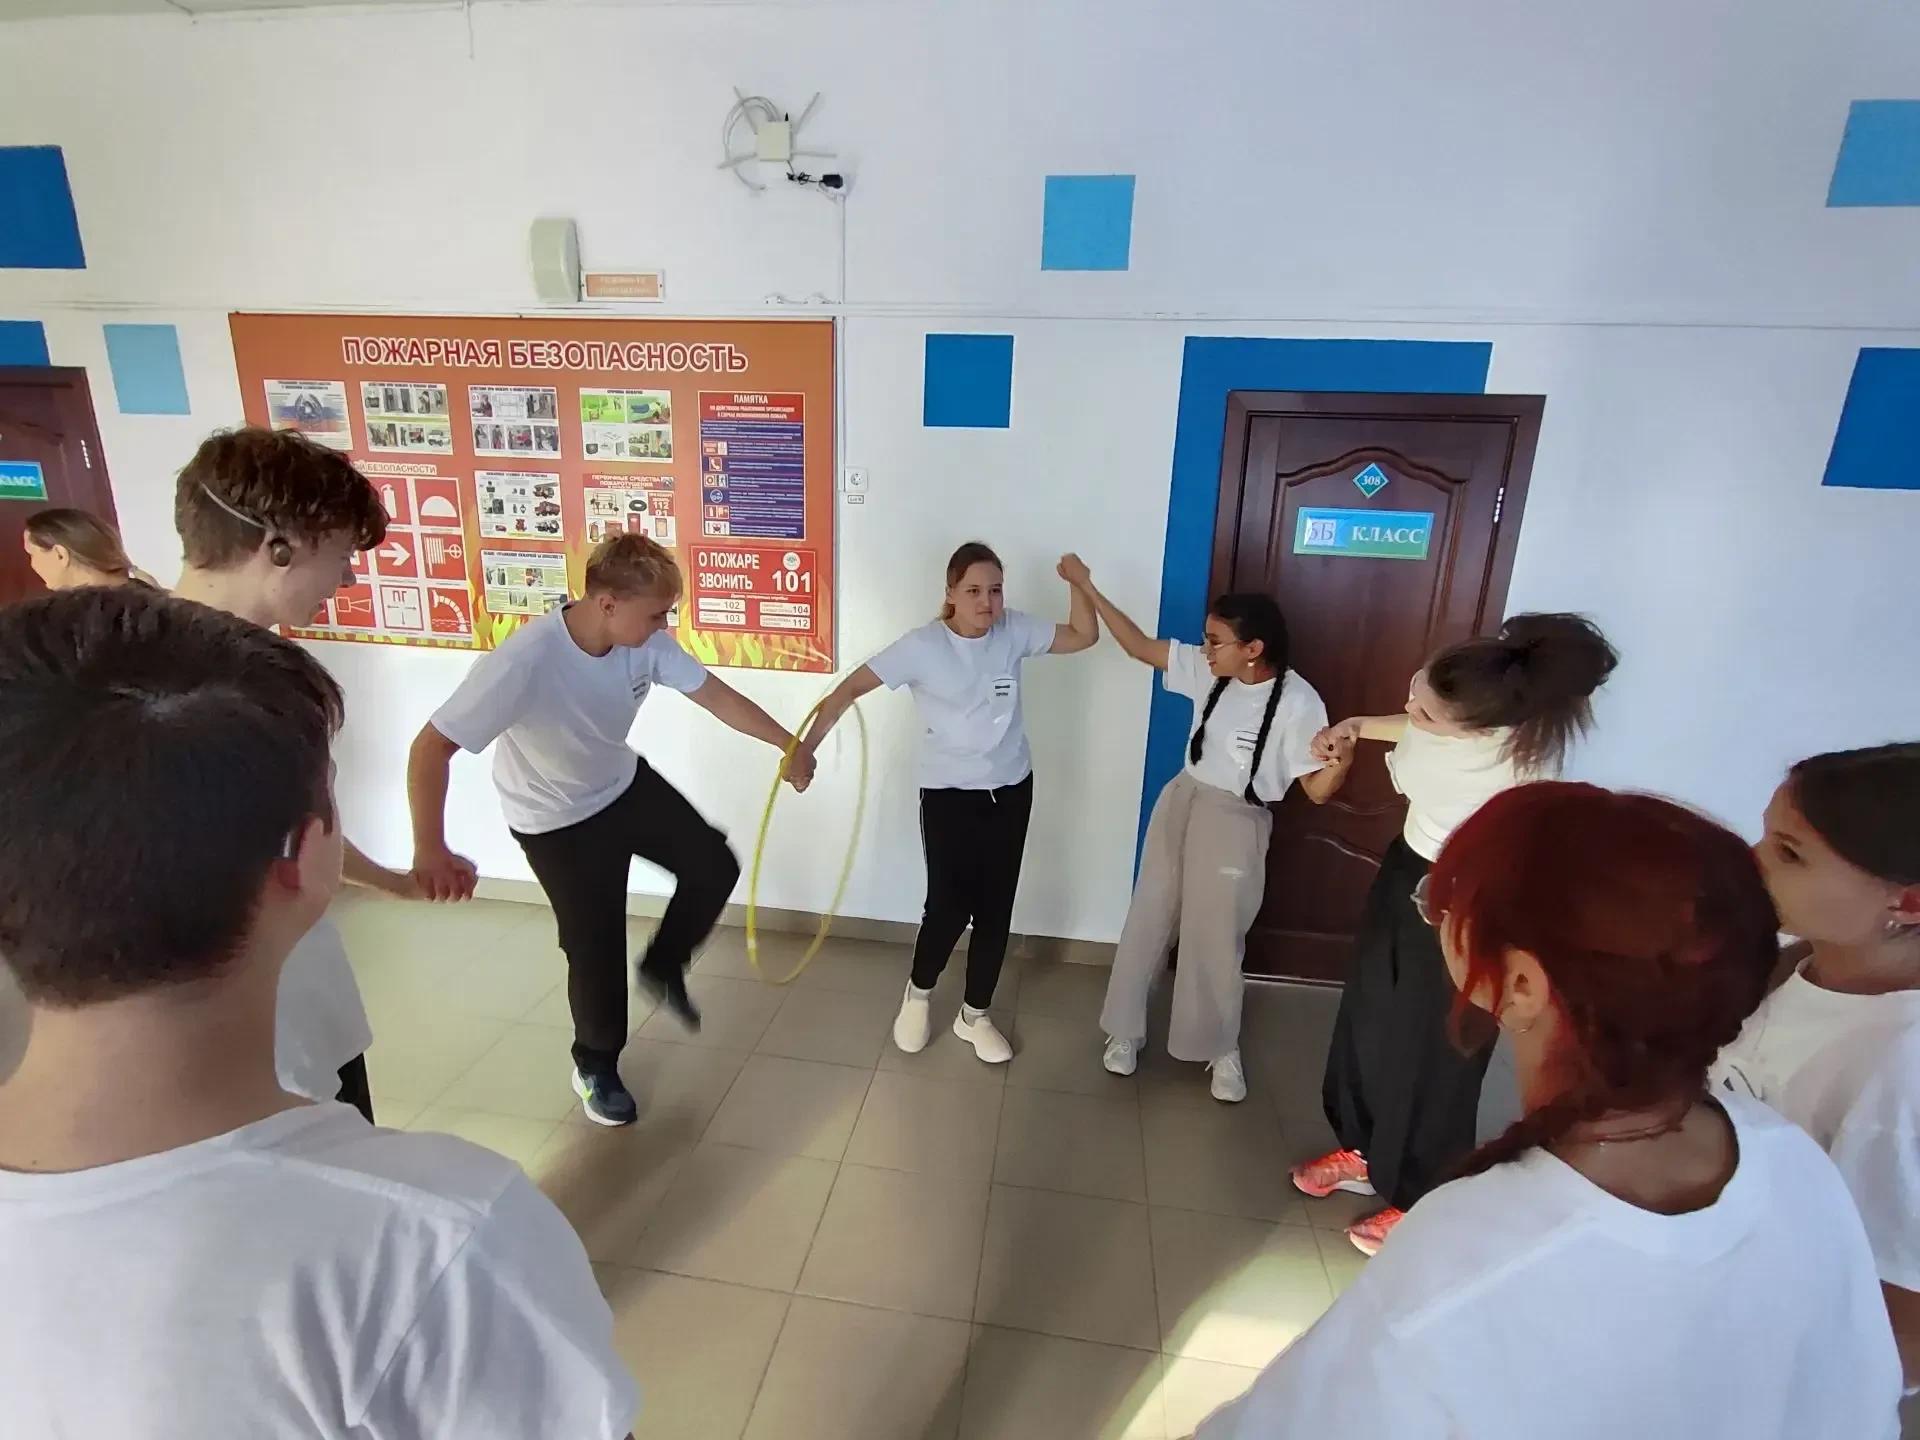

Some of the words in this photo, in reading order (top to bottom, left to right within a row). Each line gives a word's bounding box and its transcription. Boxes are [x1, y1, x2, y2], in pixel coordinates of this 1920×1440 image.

[342, 337, 502, 367] ПОЖАРНАЯ
[508, 340, 748, 372] БЕЗОПАСНОСТЬ
[734, 394, 768, 404] ПАМЯТКА
[367, 463, 436, 474] БЕЗОПАСНОСТИ
[1361, 476, 1381, 486] 308
[654, 501, 669, 510] 112
[1352, 526, 1425, 544] КЛАСС
[698, 551, 707, 567] О
[710, 552, 760, 569] ПОЖАРЕ
[699, 572, 753, 590] ЗВОНИТЬ
[772, 570, 811, 593] 101
[724, 601, 740, 609] 102
[792, 605, 809, 614] 104
[725, 614, 740, 623] 103
[793, 619, 808, 627] 112
